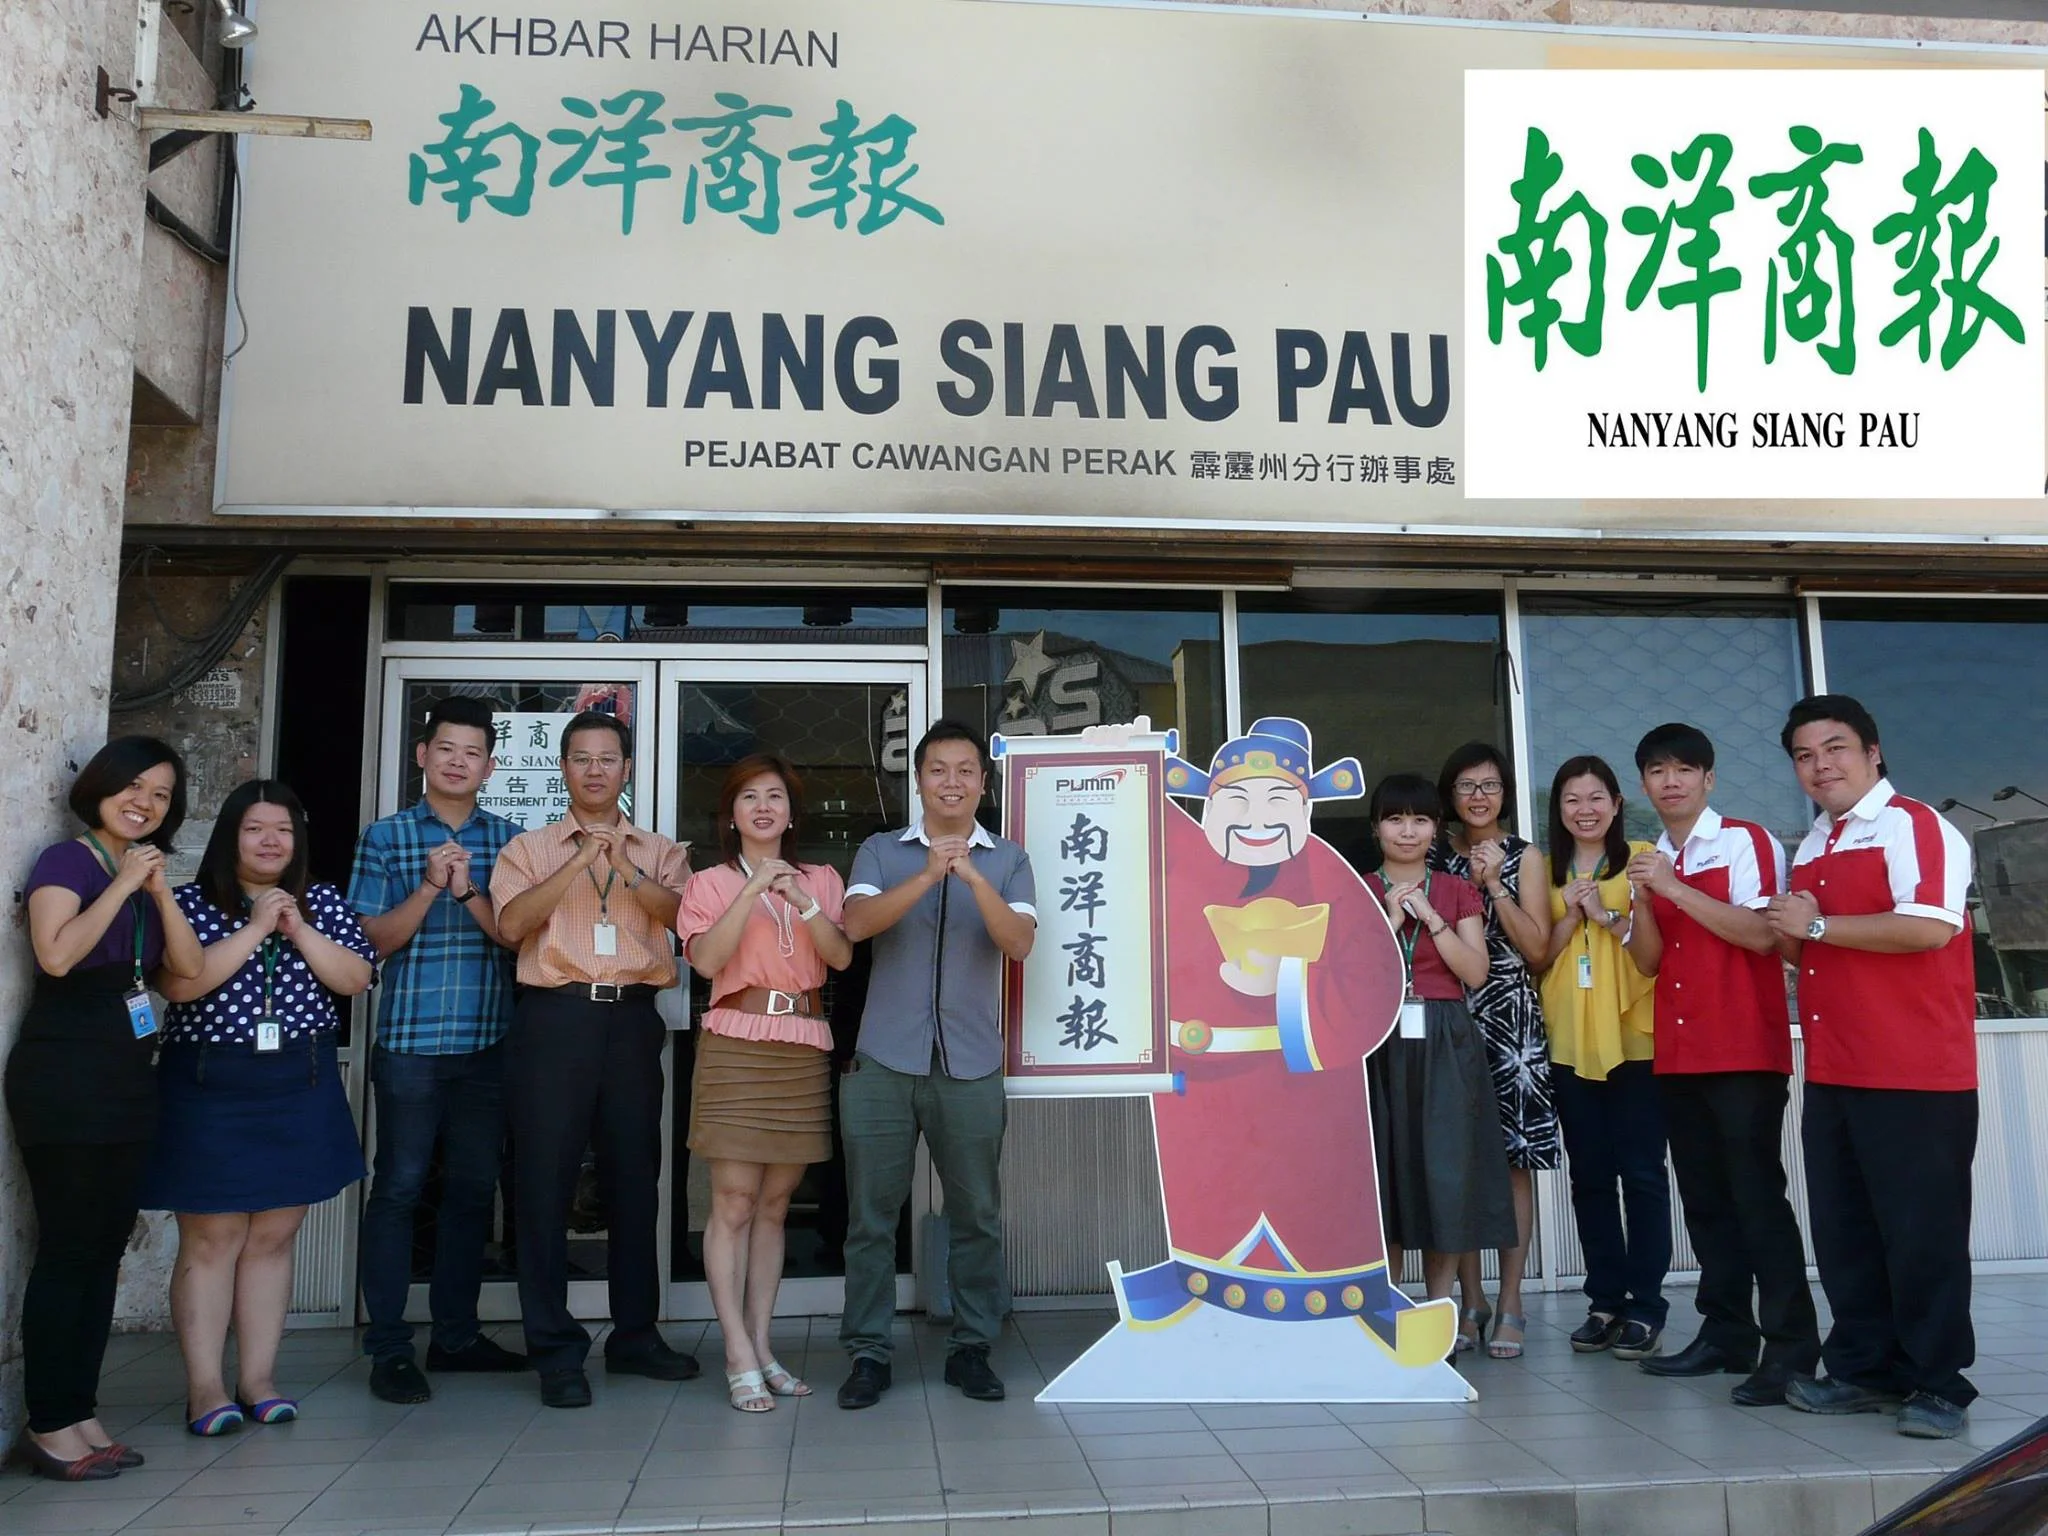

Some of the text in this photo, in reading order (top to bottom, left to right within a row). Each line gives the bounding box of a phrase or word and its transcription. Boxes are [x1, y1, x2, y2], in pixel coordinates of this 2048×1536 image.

[416, 14, 838, 68] AKHBAR HARIAN
[409, 84, 944, 235] 南洋商報
[403, 306, 1451, 428] NANYANG SIANG PAU
[685, 440, 841, 468] PEJABAT
[852, 443, 1050, 473] CAWANGAN
[1063, 448, 1177, 476] PERAK
[1056, 777, 1116, 792] PUMM
[1056, 813, 1118, 1051] 南洋商報
